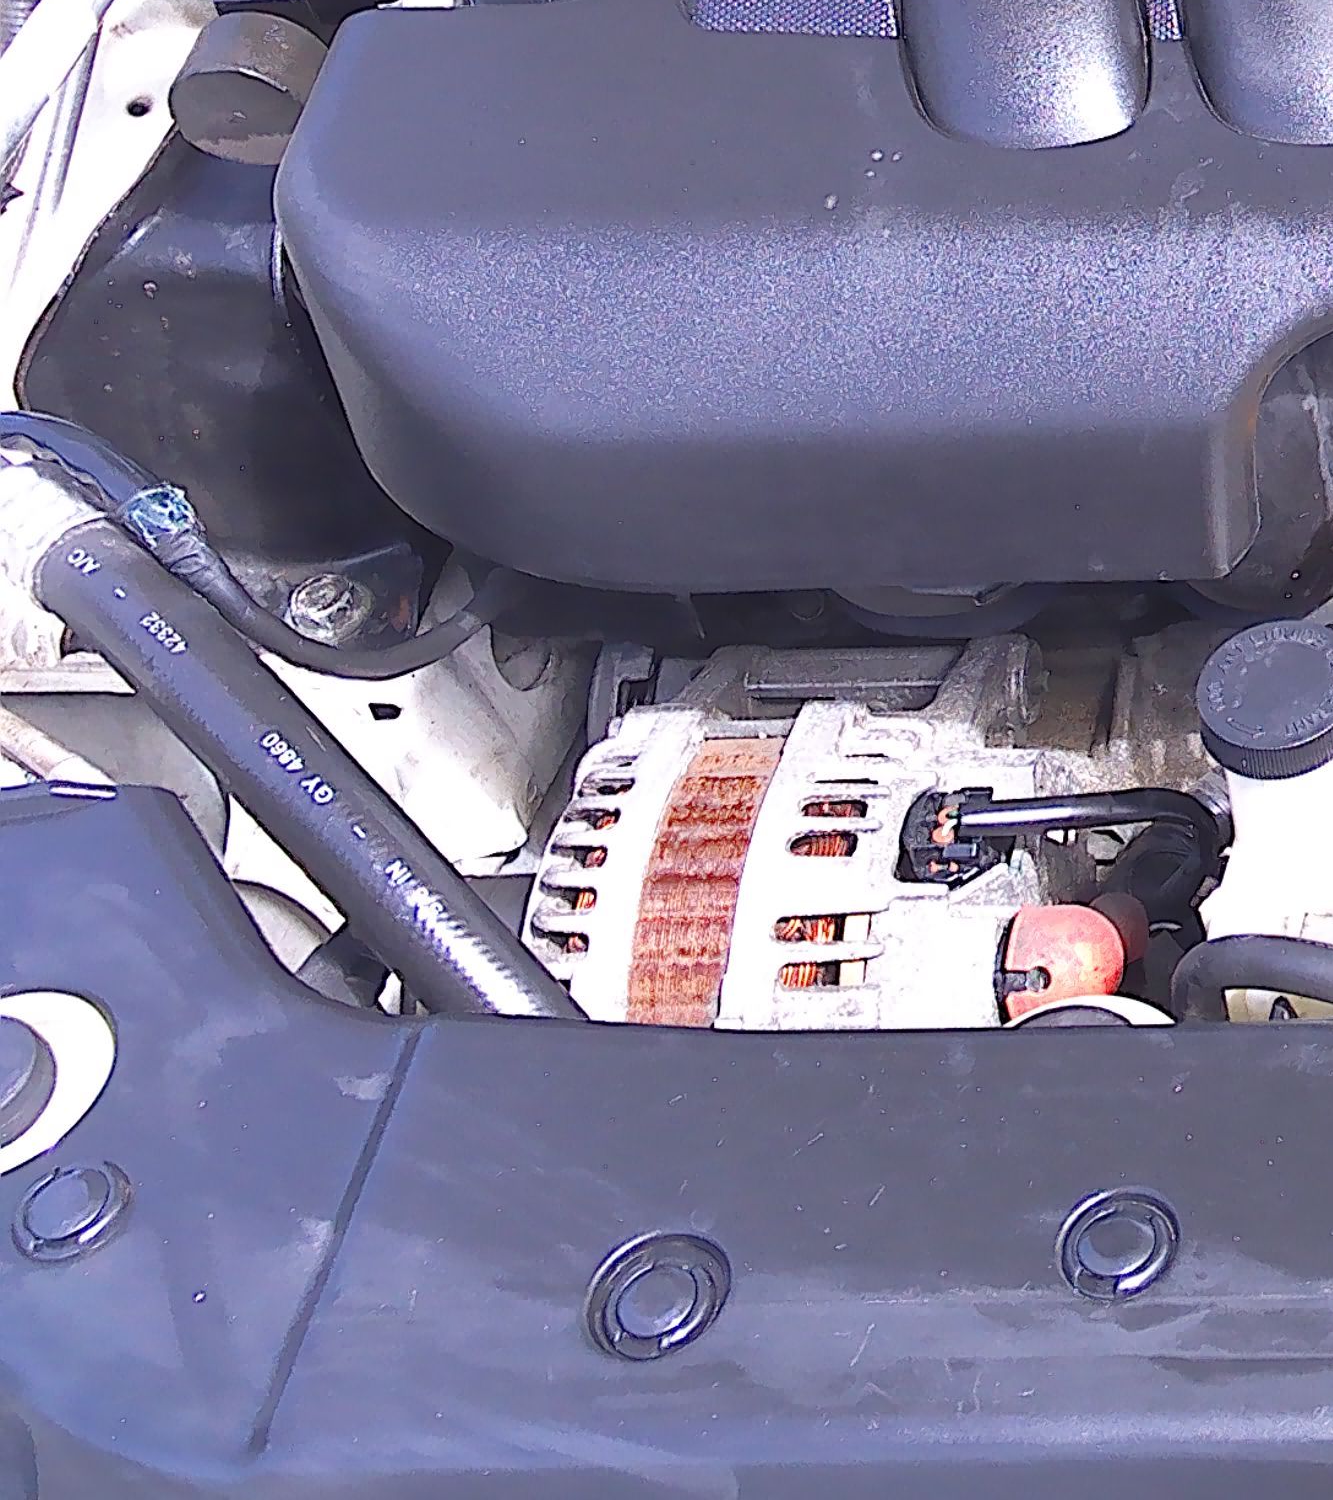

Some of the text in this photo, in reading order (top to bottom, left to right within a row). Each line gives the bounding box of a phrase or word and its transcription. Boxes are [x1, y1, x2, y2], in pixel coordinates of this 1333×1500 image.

[66, 548, 102, 575] A/C
[139, 611, 188, 655] 42332
[260, 732, 305, 773] 4860
[301, 775, 334, 805] GY
[384, 859, 413, 886] IN
